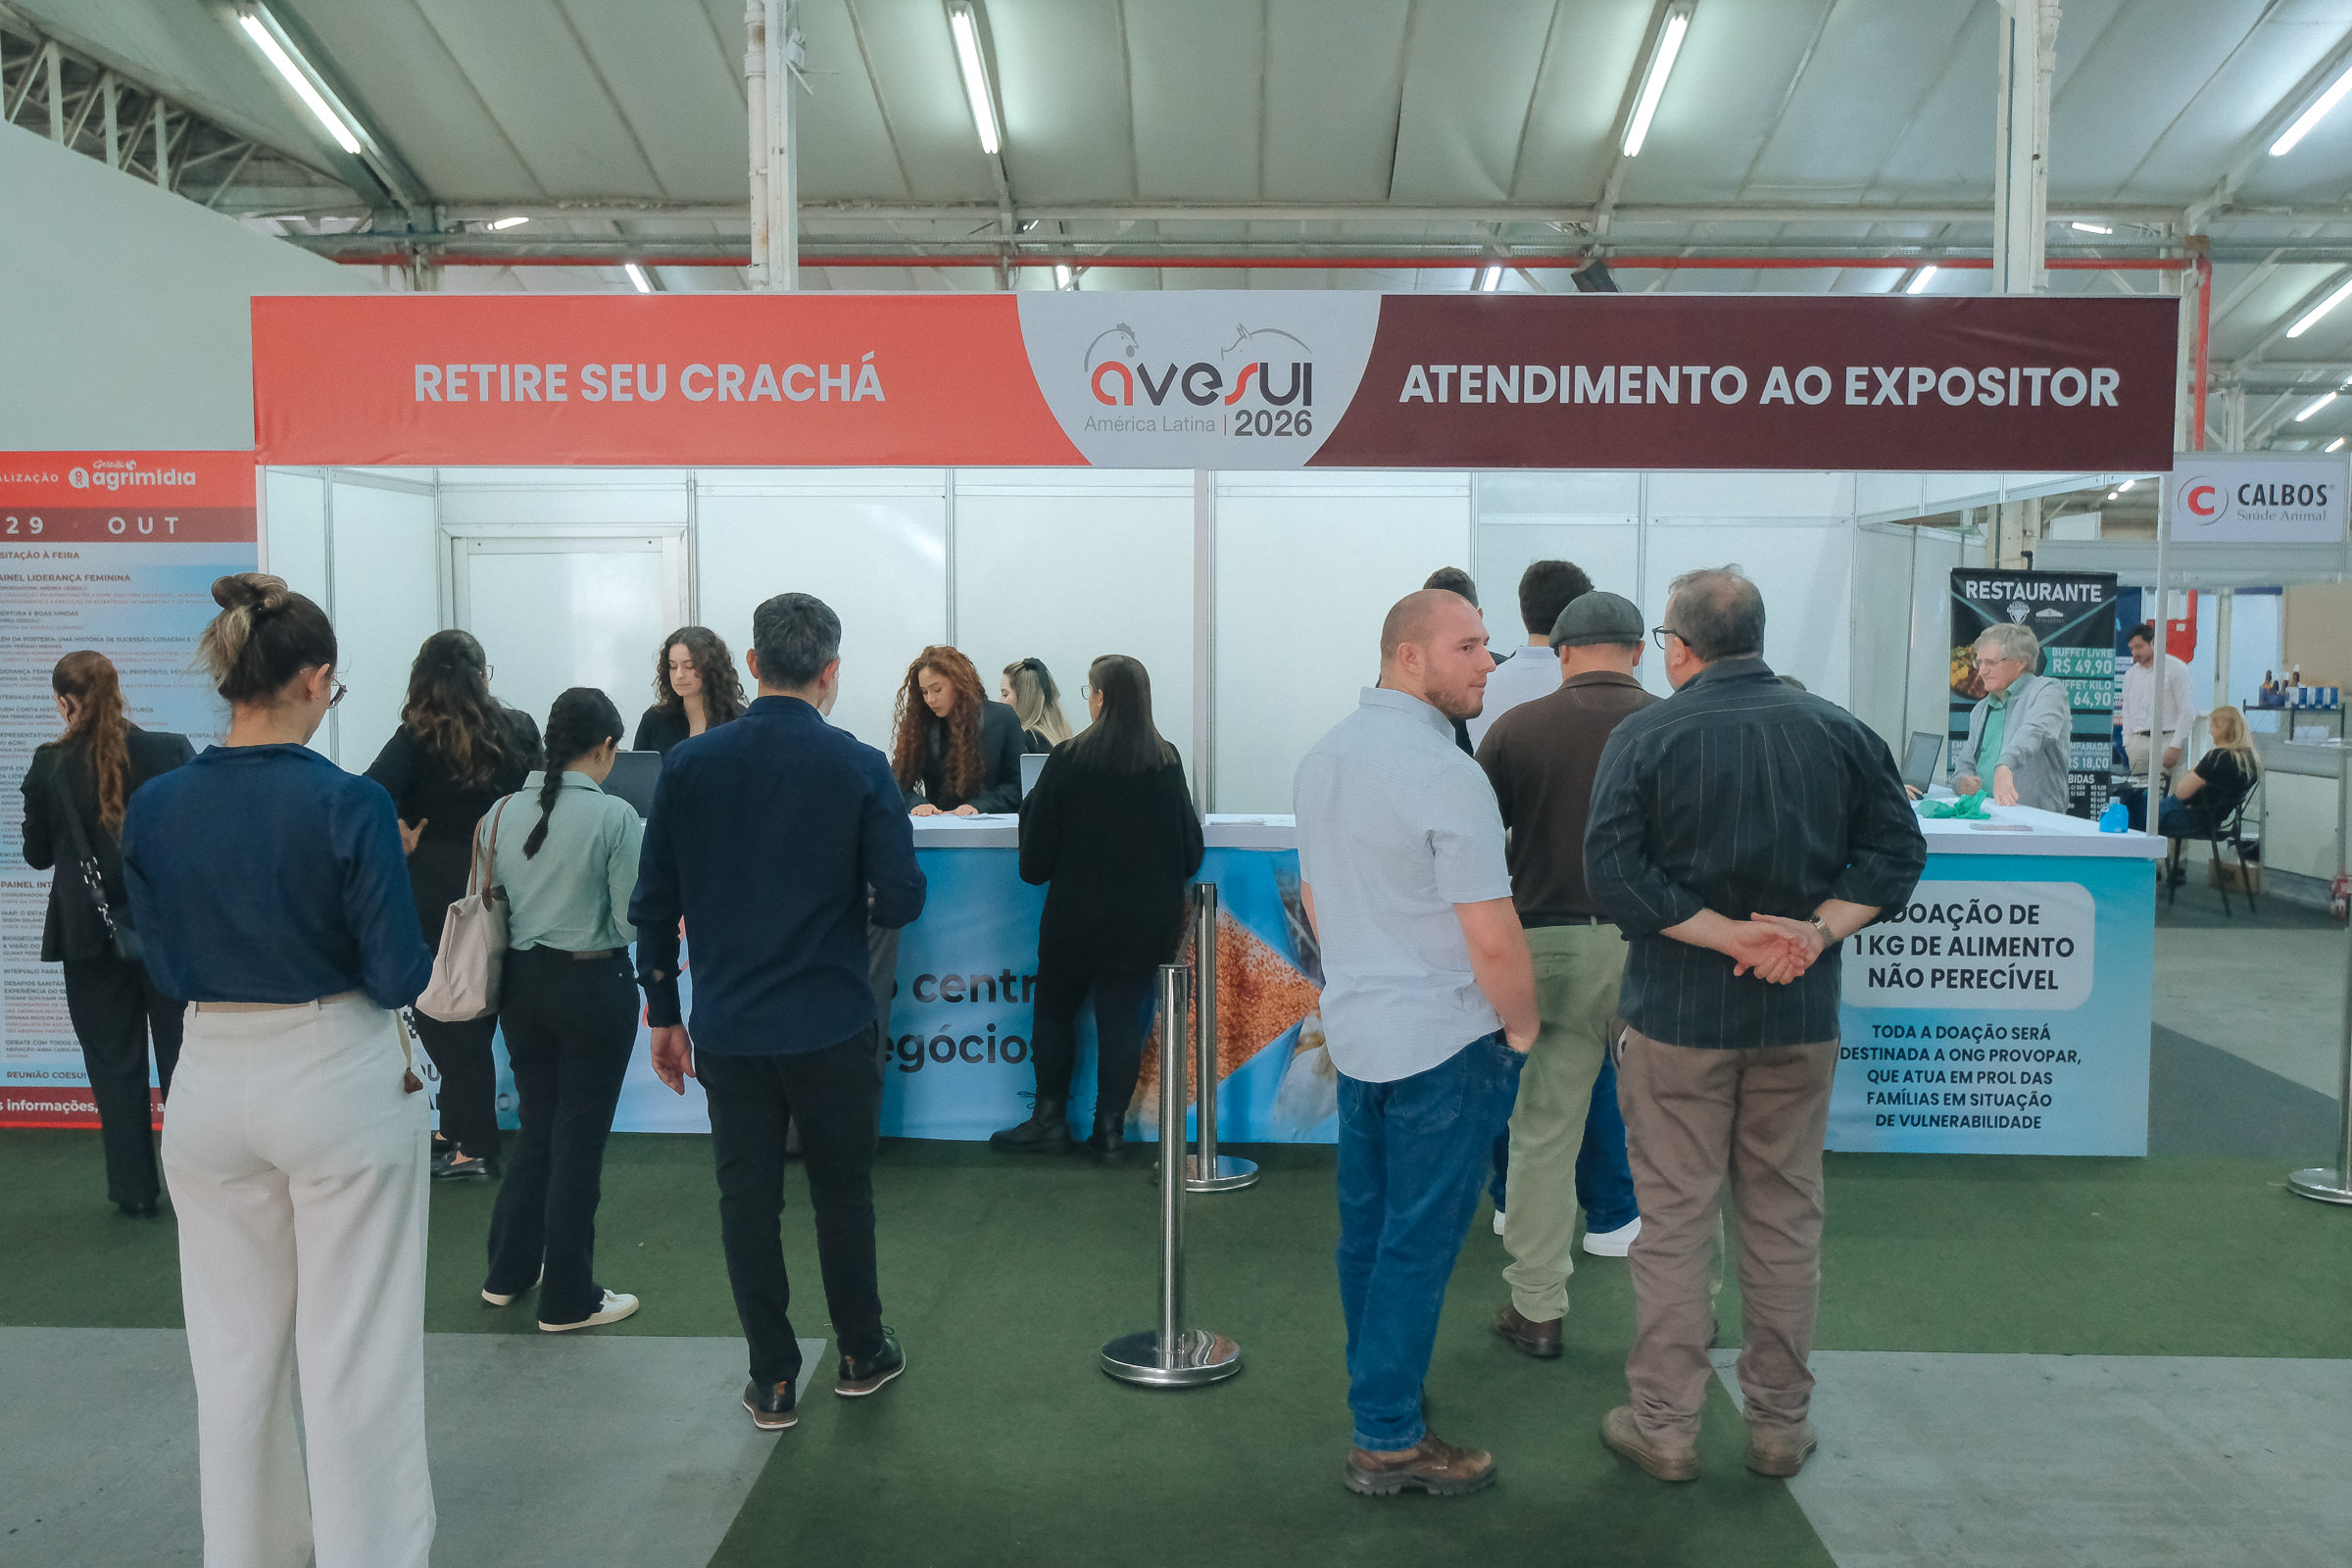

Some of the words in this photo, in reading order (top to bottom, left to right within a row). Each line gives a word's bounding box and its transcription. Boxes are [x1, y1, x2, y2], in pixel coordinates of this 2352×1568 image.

[415, 364, 567, 402] RETIRE
[580, 364, 667, 402] SEU
[680, 351, 886, 402] CRACHÁ
[1398, 365, 1747, 405] ATENDIMENTO
[1759, 366, 1832, 406] AO
[1845, 367, 2120, 407] EXPOSITOR
[1084, 416, 1156, 432] América
[1162, 416, 1215, 432] Latina
[1234, 410, 1312, 436] 2026
[92, 468, 196, 491] agrimidia
[2237, 484, 2328, 507] CALBOS
[2236, 510, 2276, 521] Saúde
[2279, 510, 2327, 521] Animal
[6, 516, 44, 535] 29
[108, 516, 178, 535] OUT
[27, 574, 82, 583] LIDERANÇA
[1965, 579, 2102, 603] RESTAURANTE
[2051, 647, 2085, 658] BUFFET
[2086, 648, 2113, 659] LIVRE
[2052, 657, 2072, 674] R$
[2075, 659, 2112, 676] 49,90
[2062, 680, 2087, 690] FFET
[2089, 680, 2112, 691] KILO
[2073, 691, 2112, 708] 64,90
[2070, 742, 2109, 751] MPANADA
[2068, 774, 2095, 784] BIDAS
[2009, 905, 2039, 924] DE
[1853, 935, 1862, 955] 1
[1869, 935, 1905, 956] KG
[1911, 936, 1941, 956] DE
[1947, 937, 2075, 957] ALIMENTO
[912, 968, 1039, 1004] centr
[1868, 963, 1925, 988] NÃO
[1931, 963, 2058, 990] PERECÍVEL
[1872, 1025, 1916, 1039] TODA
[1921, 1026, 1932, 1039] A
[1936, 1023, 2007, 1044] DOAÇÃO
[2011, 1023, 2051, 1041] SERÁ
[1839, 1047, 1930, 1061] DESTINADA
[1934, 1049, 1945, 1061] A
[1949, 1049, 1985, 1061] ONG
[1989, 1050, 2082, 1065] PROVOPAR,
[7, 1070, 50, 1079] REUNIÃO
[1867, 1069, 1899, 1084] QUE
[1902, 1070, 1946, 1084] ATUA
[1950, 1070, 1973, 1084] EM
[1977, 1071, 2017, 1085] PROL
[2021, 1071, 2053, 1085] DAS
[7, 1099, 99, 1114] informações,
[1867, 1089, 1939, 1106] FAMÍLIAS
[1943, 1093, 1966, 1106] EM
[1970, 1091, 2052, 1111] SITUAÇÃO
[1875, 1114, 1895, 1127] DE
[1899, 1114, 2041, 1129] VULNERABILIDADE
